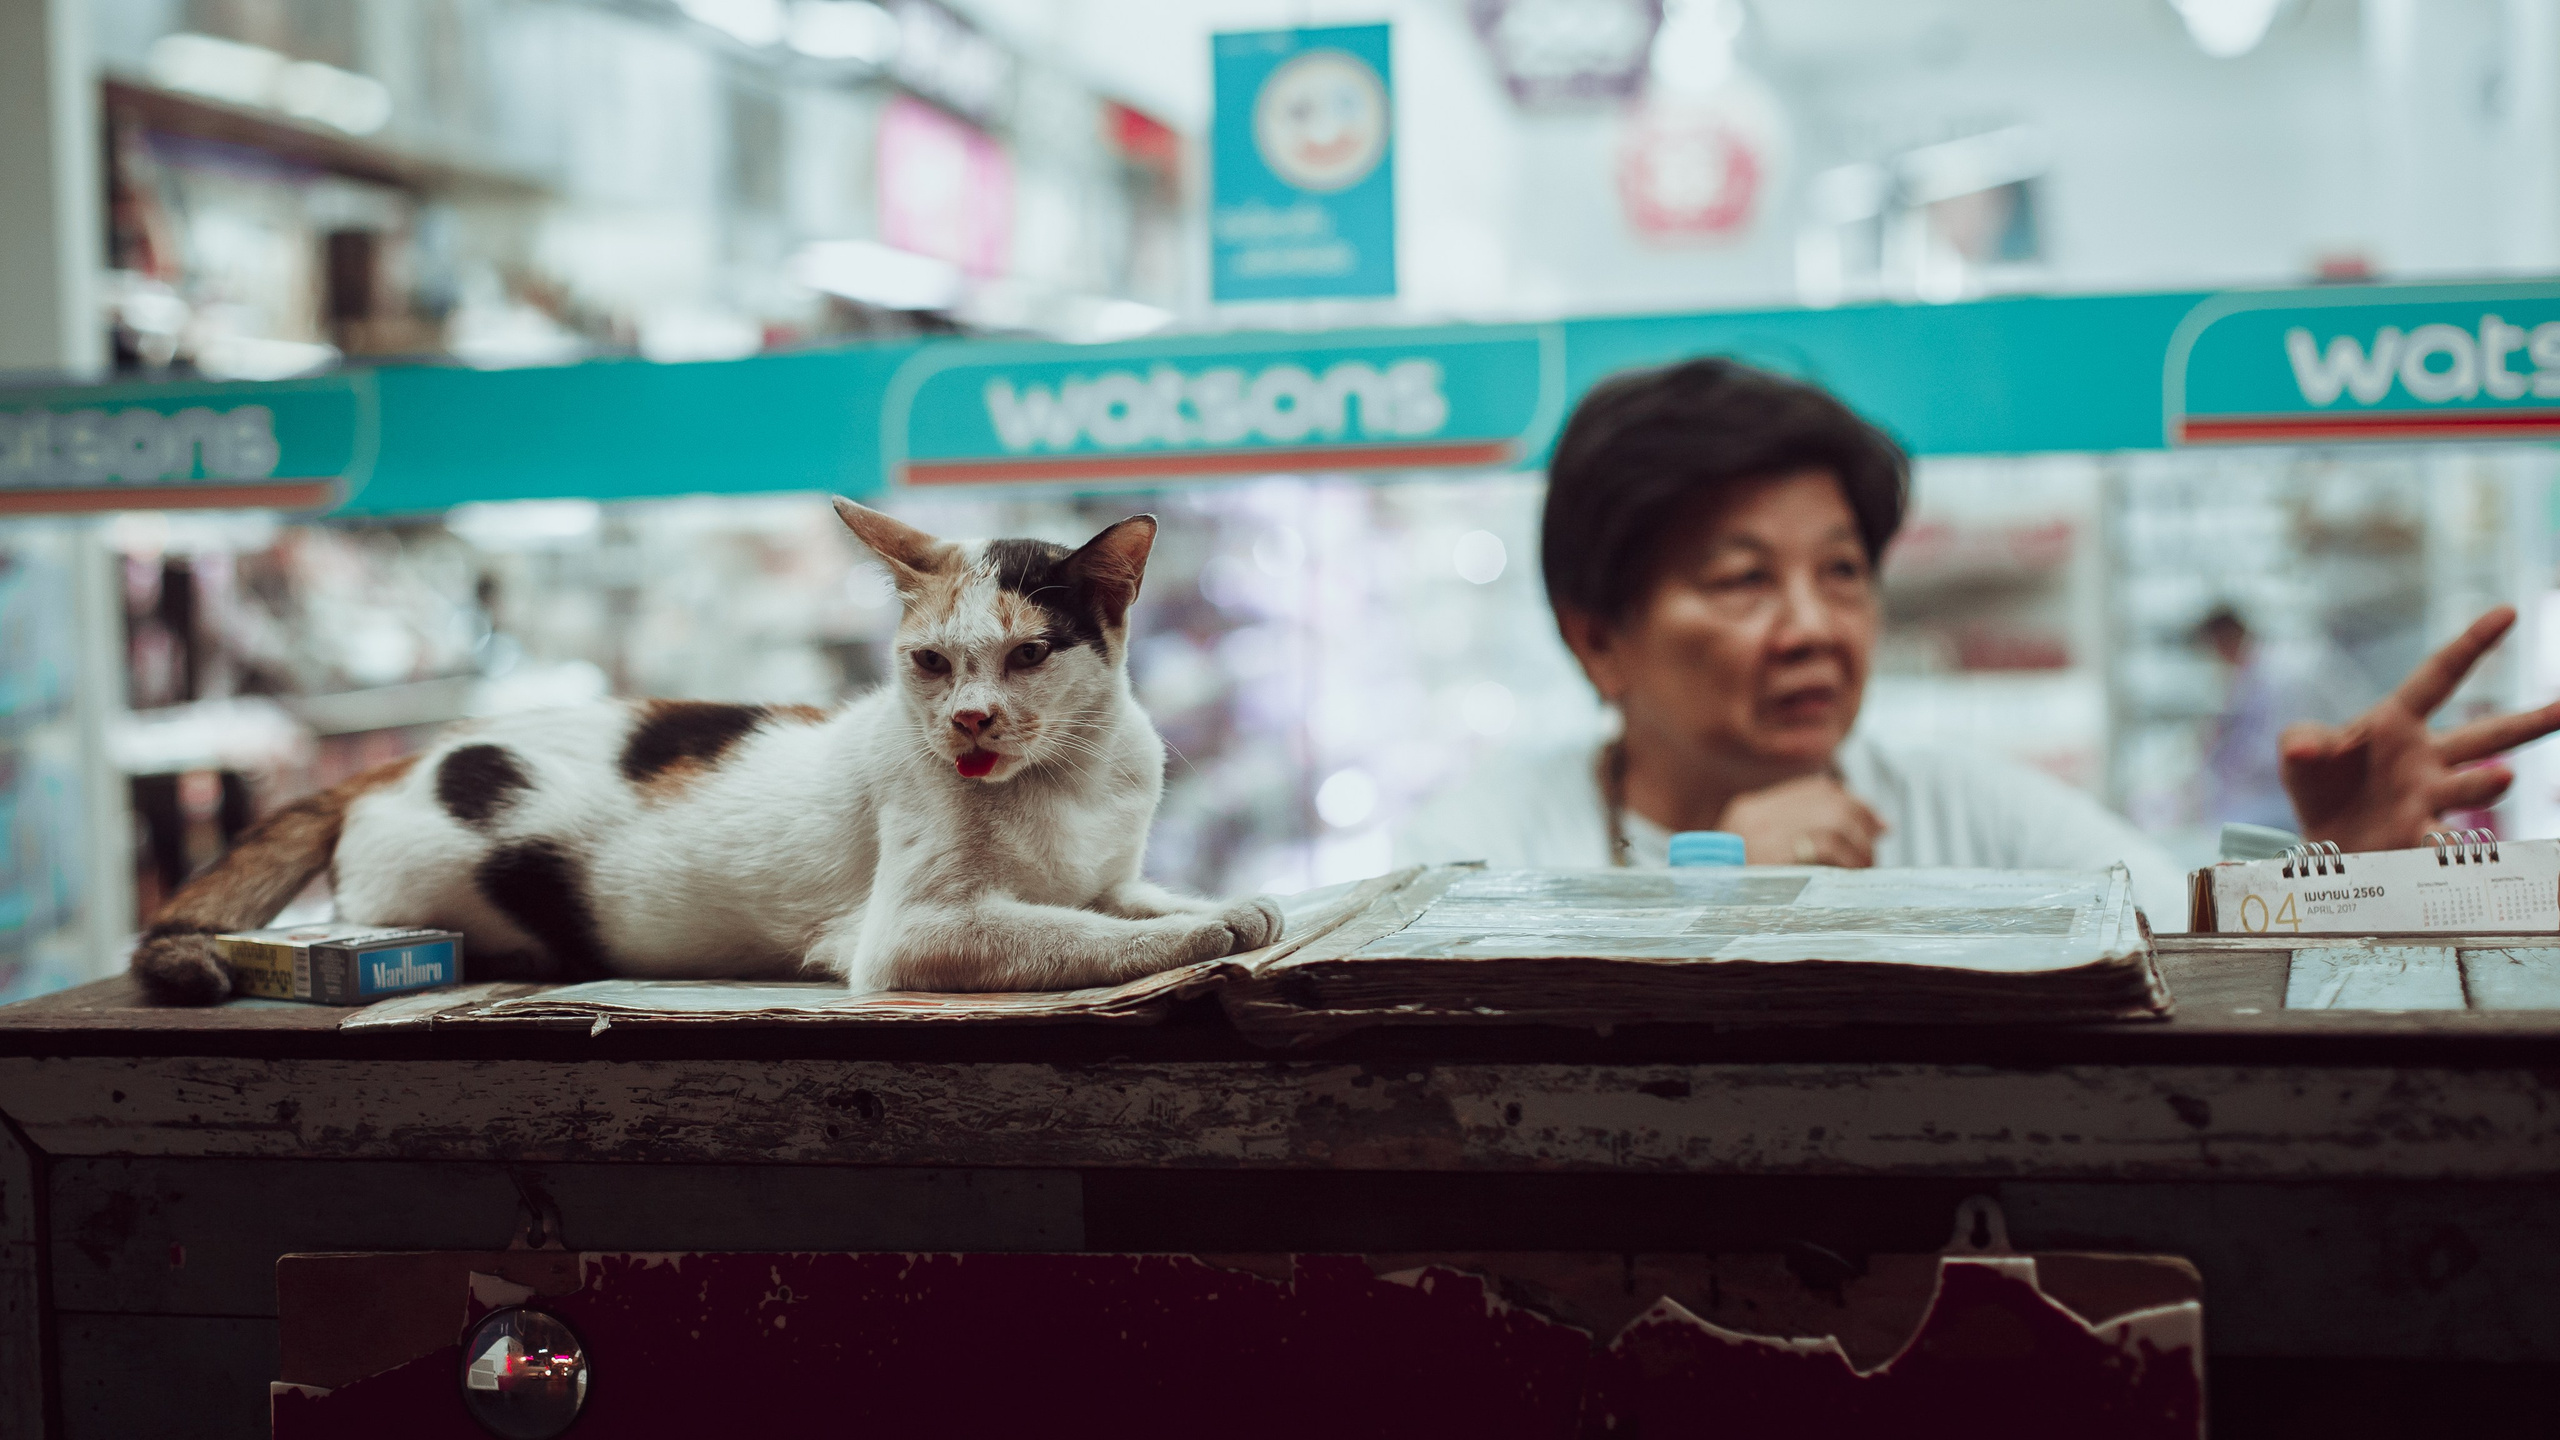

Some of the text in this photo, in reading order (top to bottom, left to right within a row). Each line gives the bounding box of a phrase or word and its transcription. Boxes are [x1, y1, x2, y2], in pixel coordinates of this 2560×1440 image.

[984, 359, 1448, 451] watsons
[2240, 892, 2303, 933] 04
[2304, 885, 2385, 903] เมษายน 2560
[2307, 902, 2358, 916] APRIL 2017
[372, 951, 442, 989] Marlboro
